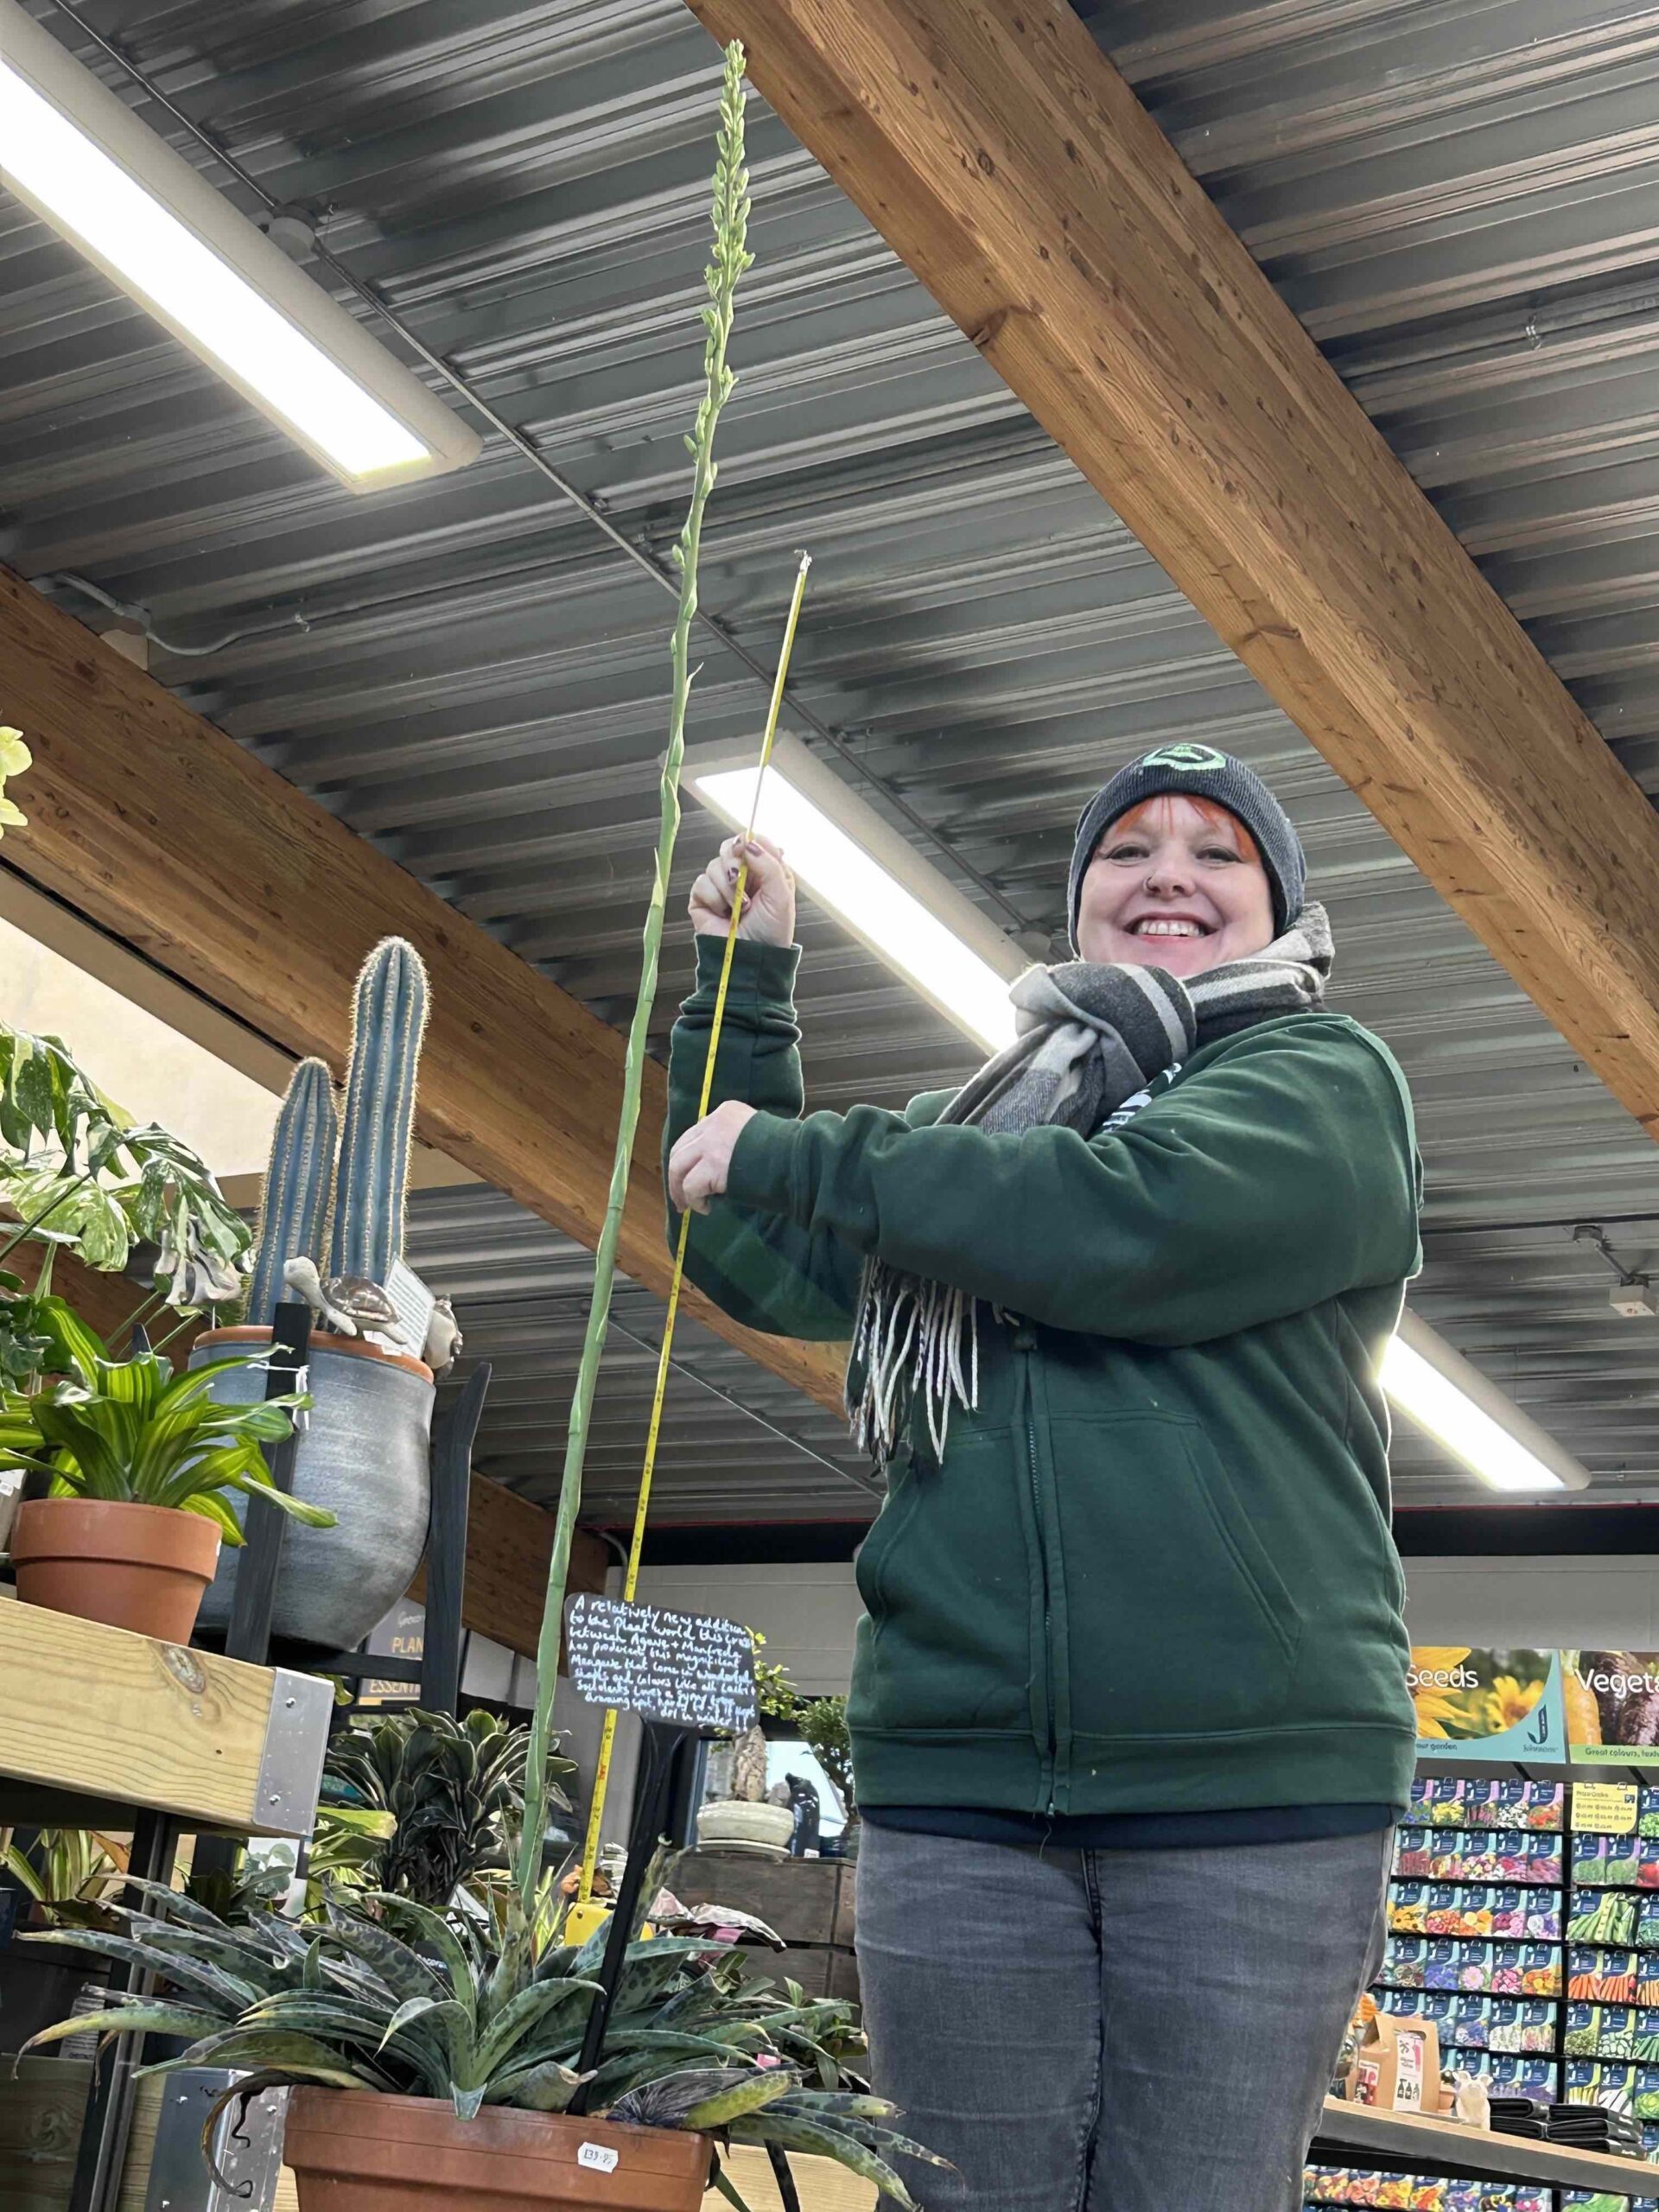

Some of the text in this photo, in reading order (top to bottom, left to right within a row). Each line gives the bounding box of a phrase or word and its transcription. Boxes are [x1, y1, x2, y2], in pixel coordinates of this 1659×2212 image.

[575, 1594, 585, 1610] A
[590, 1599, 661, 1630] relatively
[664, 1612, 691, 1624] new
[569, 1610, 584, 1624] to
[588, 1614, 611, 1628] the
[699, 1627, 722, 1643] this
[569, 1626, 626, 1643] between
[631, 1633, 670, 1652] Agave
[681, 1640, 742, 1658] Manfreda
[569, 1639, 588, 1651] has
[592, 1641, 645, 1657] produced
[650, 1647, 671, 1660] this
[624, 1656, 648, 1670] that
[1405, 1664, 1479, 1688] Seeds
[1585, 1747, 1608, 1756] Great
